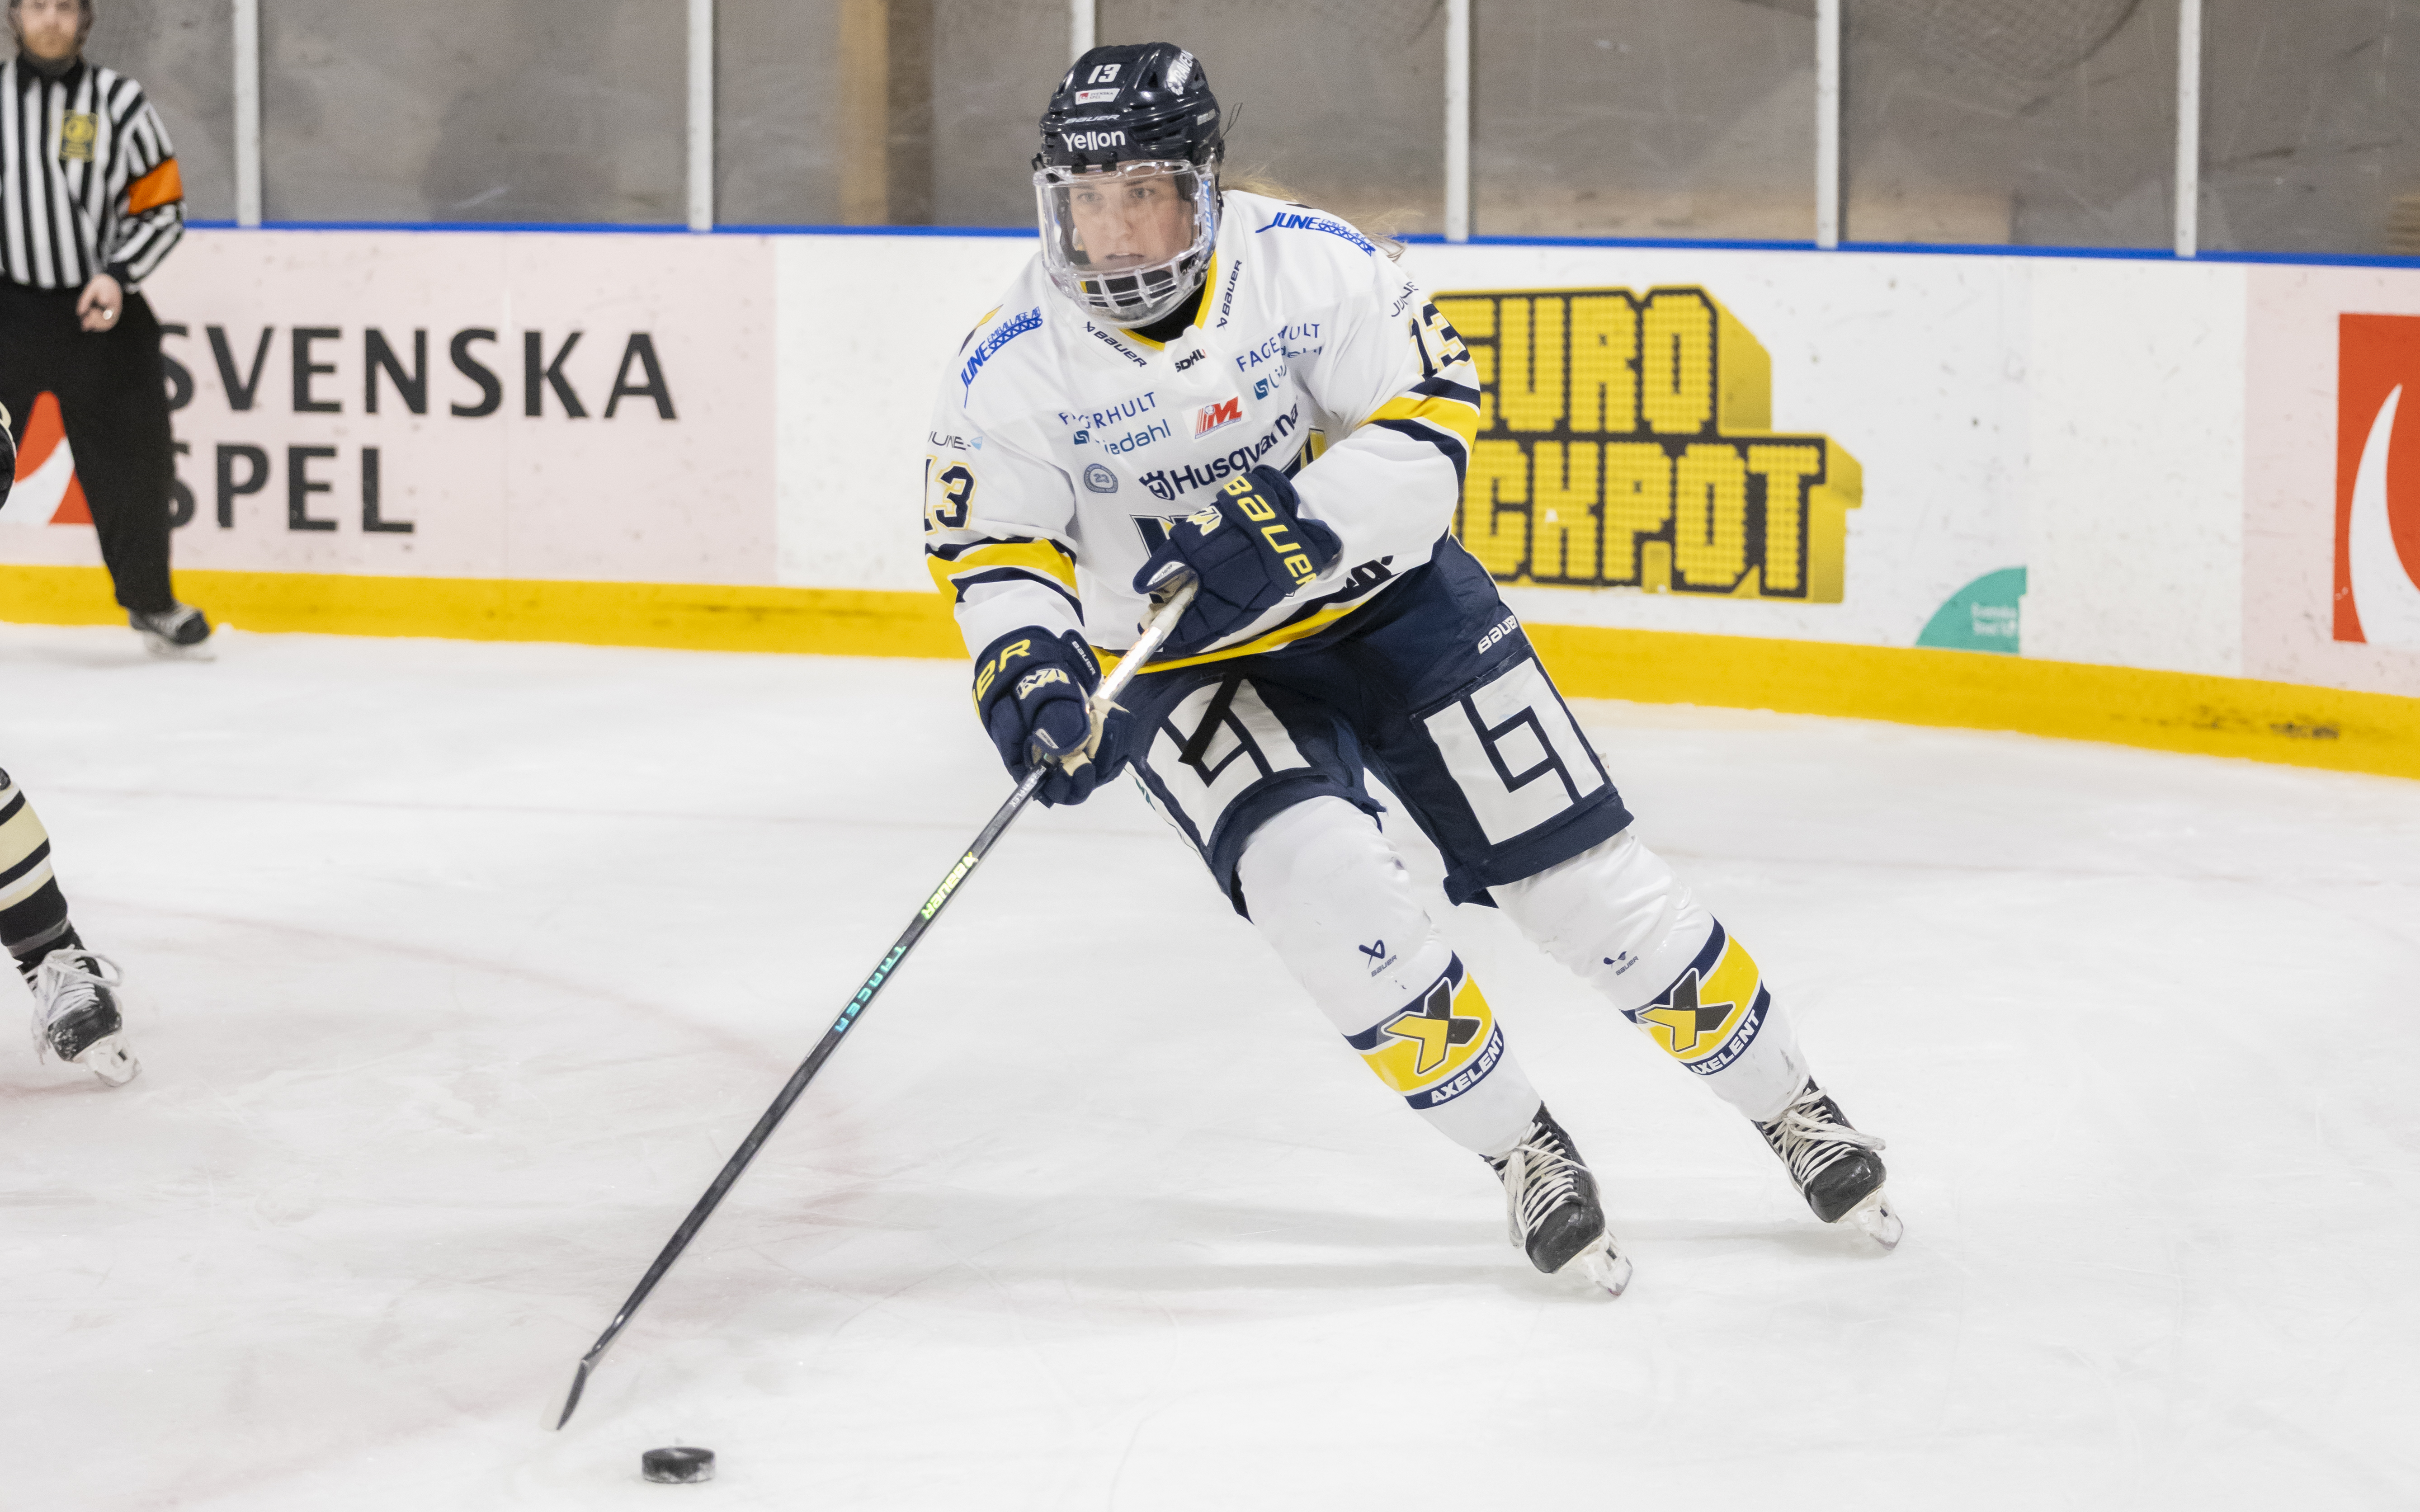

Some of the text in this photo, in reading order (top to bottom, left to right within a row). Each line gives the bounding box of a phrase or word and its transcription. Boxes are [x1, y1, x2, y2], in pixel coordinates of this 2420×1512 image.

[1087, 64, 1122, 84] 13
[1062, 131, 1126, 152] Yellon
[1262, 212, 1321, 231] JUNE
[158, 324, 679, 421] SVENSKA
[960, 339, 987, 396] JUNE
[987, 311, 1030, 344] EMBALLAGE
[1175, 349, 1206, 373] SDHL
[1407, 300, 1475, 381] 13
[1174, 403, 1298, 494] Husqvarna
[1461, 440, 1822, 591] CKPOT
[1431, 1031, 1504, 1104] AXELENT
[1690, 1009, 1760, 1075] AXELENT
